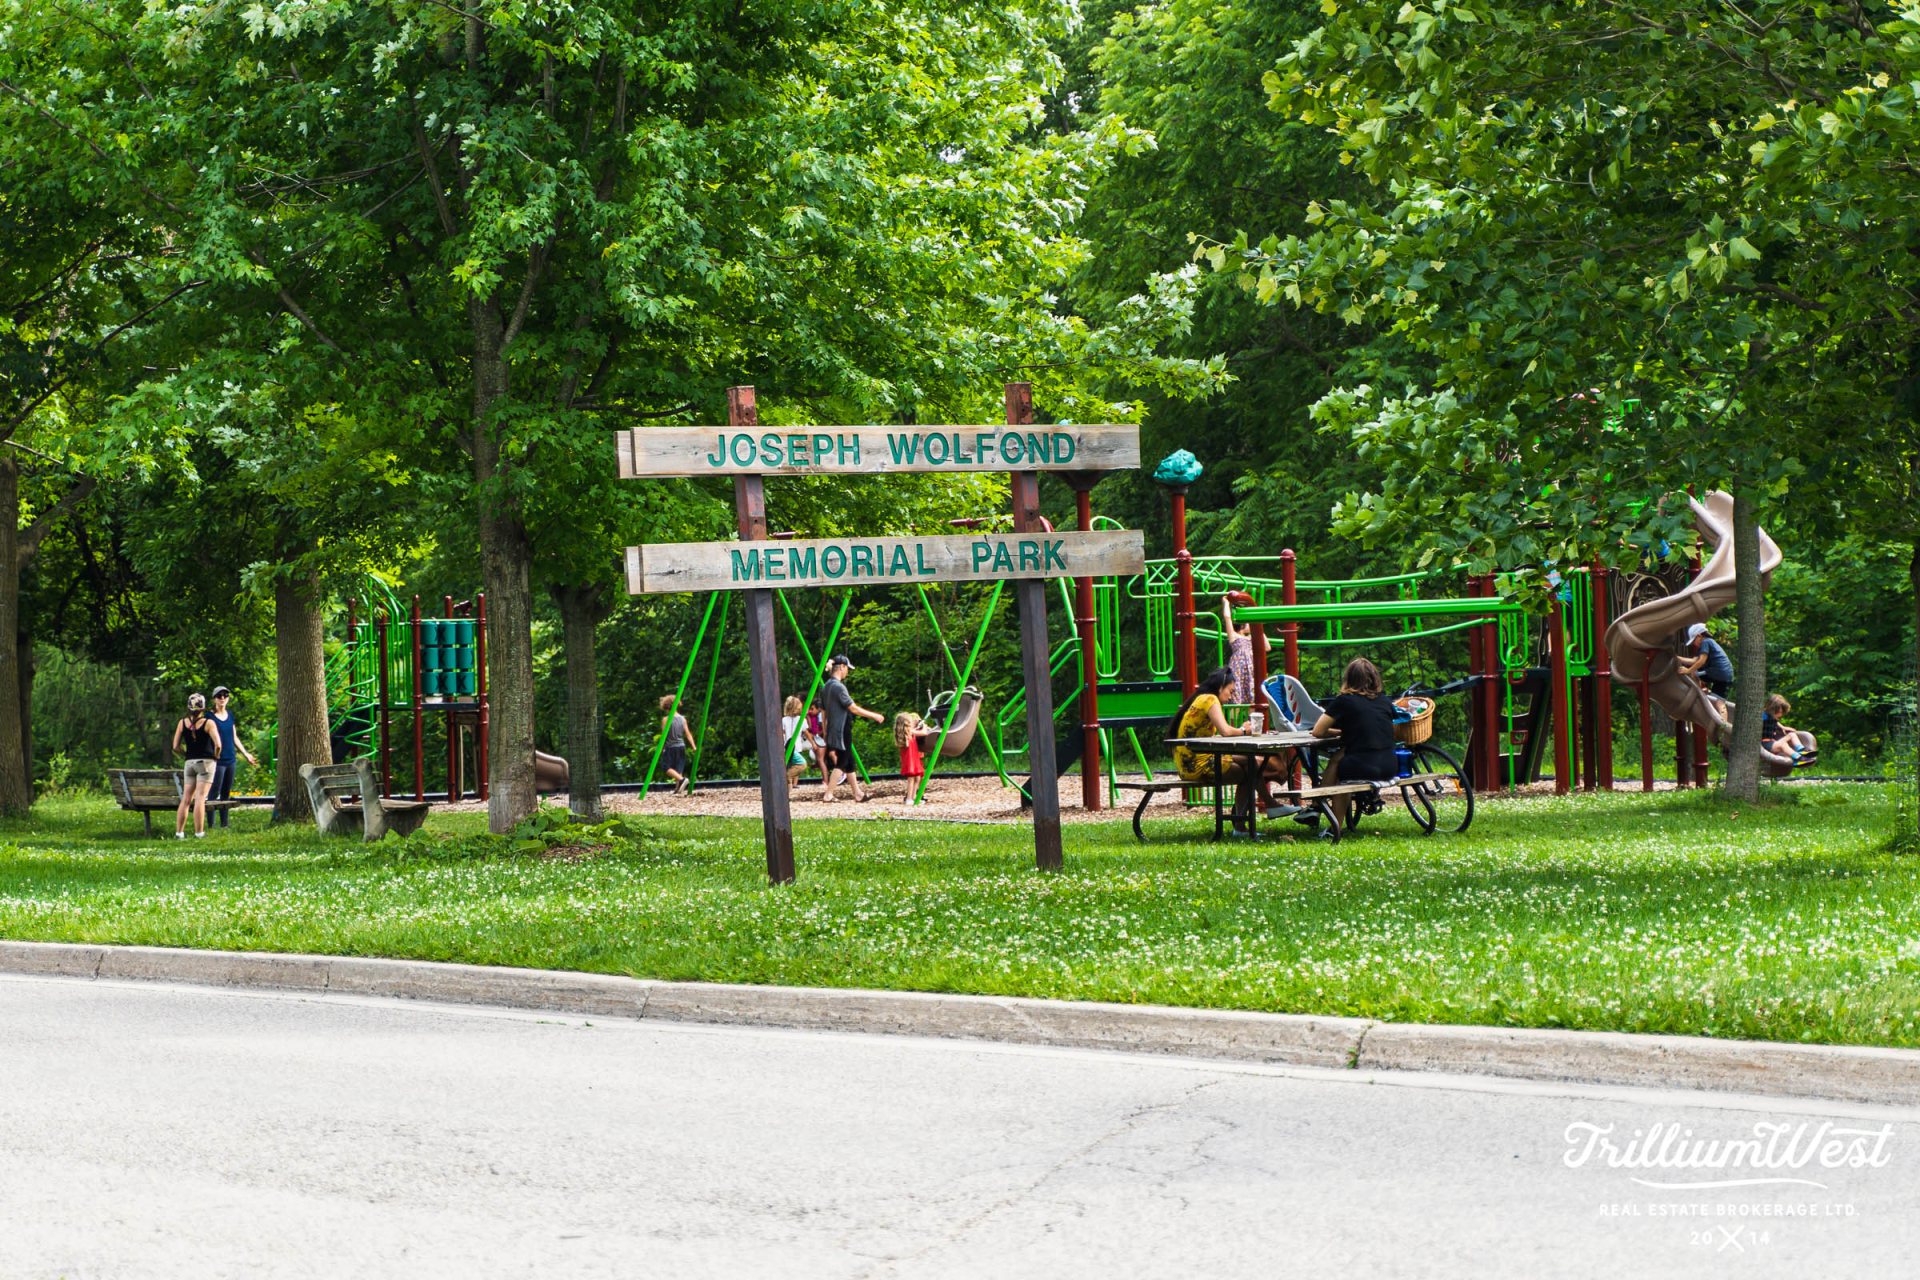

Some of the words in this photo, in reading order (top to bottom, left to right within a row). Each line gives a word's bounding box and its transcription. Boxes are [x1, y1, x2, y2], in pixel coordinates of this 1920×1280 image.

[707, 433, 860, 467] JOSEPH
[887, 432, 1075, 465] WOLFOND
[731, 543, 936, 581] MEMORIAL
[972, 540, 1067, 573] PARK
